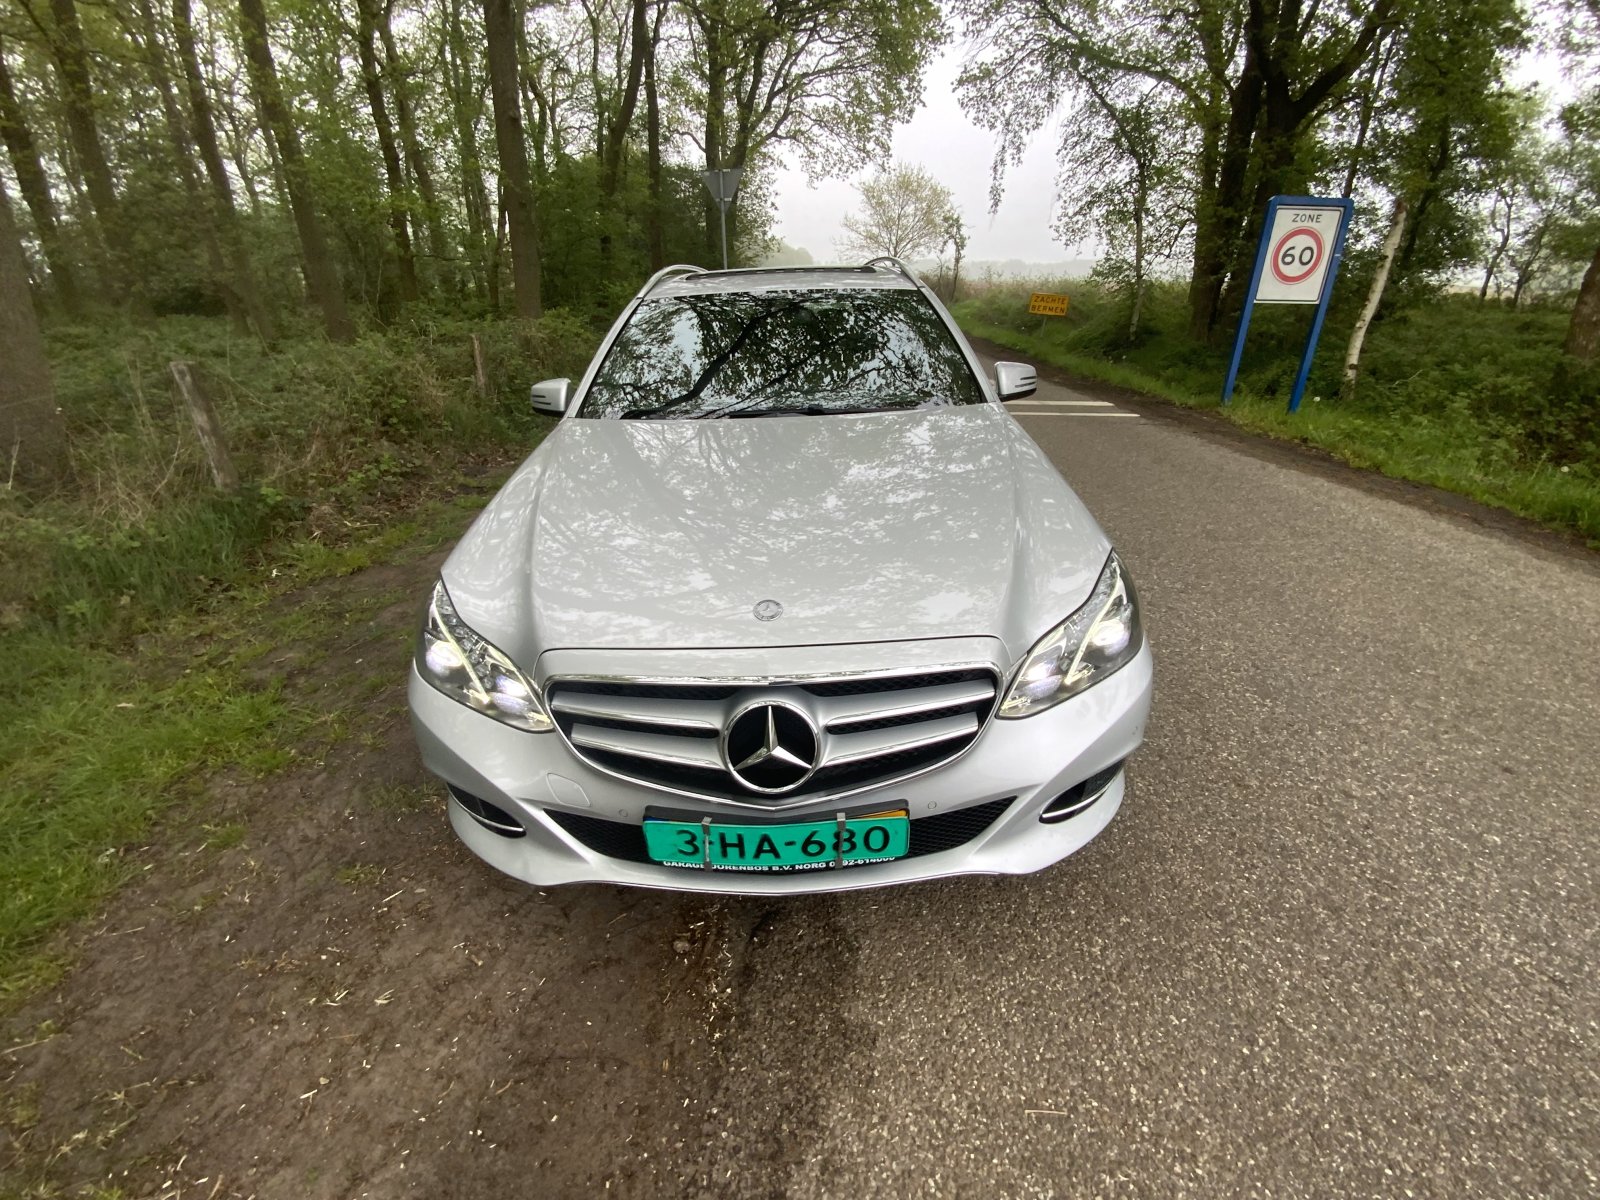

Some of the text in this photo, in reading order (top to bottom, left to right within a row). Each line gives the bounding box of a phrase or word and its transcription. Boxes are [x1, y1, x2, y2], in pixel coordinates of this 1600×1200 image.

[1291, 213, 1323, 223] ZONE
[1281, 246, 1315, 266] 60
[1033, 295, 1067, 305] ZACHTE
[1031, 304, 1065, 314] BERMEN
[676, 825, 891, 859] 3-HA-680
[795, 861, 827, 870] NORG
